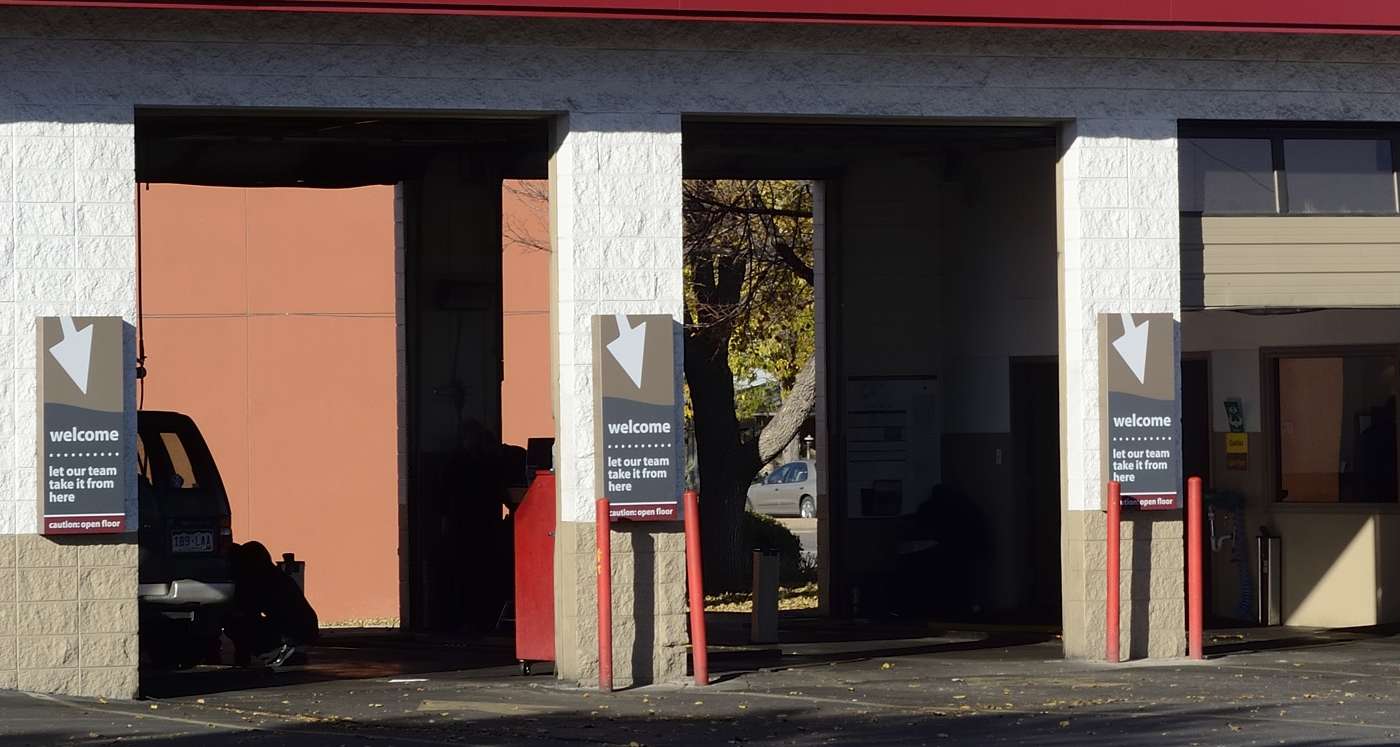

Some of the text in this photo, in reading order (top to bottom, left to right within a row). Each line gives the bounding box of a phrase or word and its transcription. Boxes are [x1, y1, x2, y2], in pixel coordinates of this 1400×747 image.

[1113, 413, 1171, 427] welcome
[608, 419, 671, 434] welcome
[49, 427, 119, 441] welcome
[1113, 448, 1170, 458] let our team
[608, 456, 669, 467] let our team
[1113, 460, 1168, 470] take it from
[49, 466, 117, 476] let our team
[608, 468, 667, 479] take it from
[1113, 472, 1135, 482] here
[49, 478, 114, 489] take it from
[608, 481, 632, 492] here
[49, 492, 75, 502] here
[1139, 499, 1156, 507] open
[1157, 497, 1173, 505] floor
[637, 509, 655, 517] open
[656, 508, 673, 516] floor
[48, 520, 121, 529] caution: open floor
